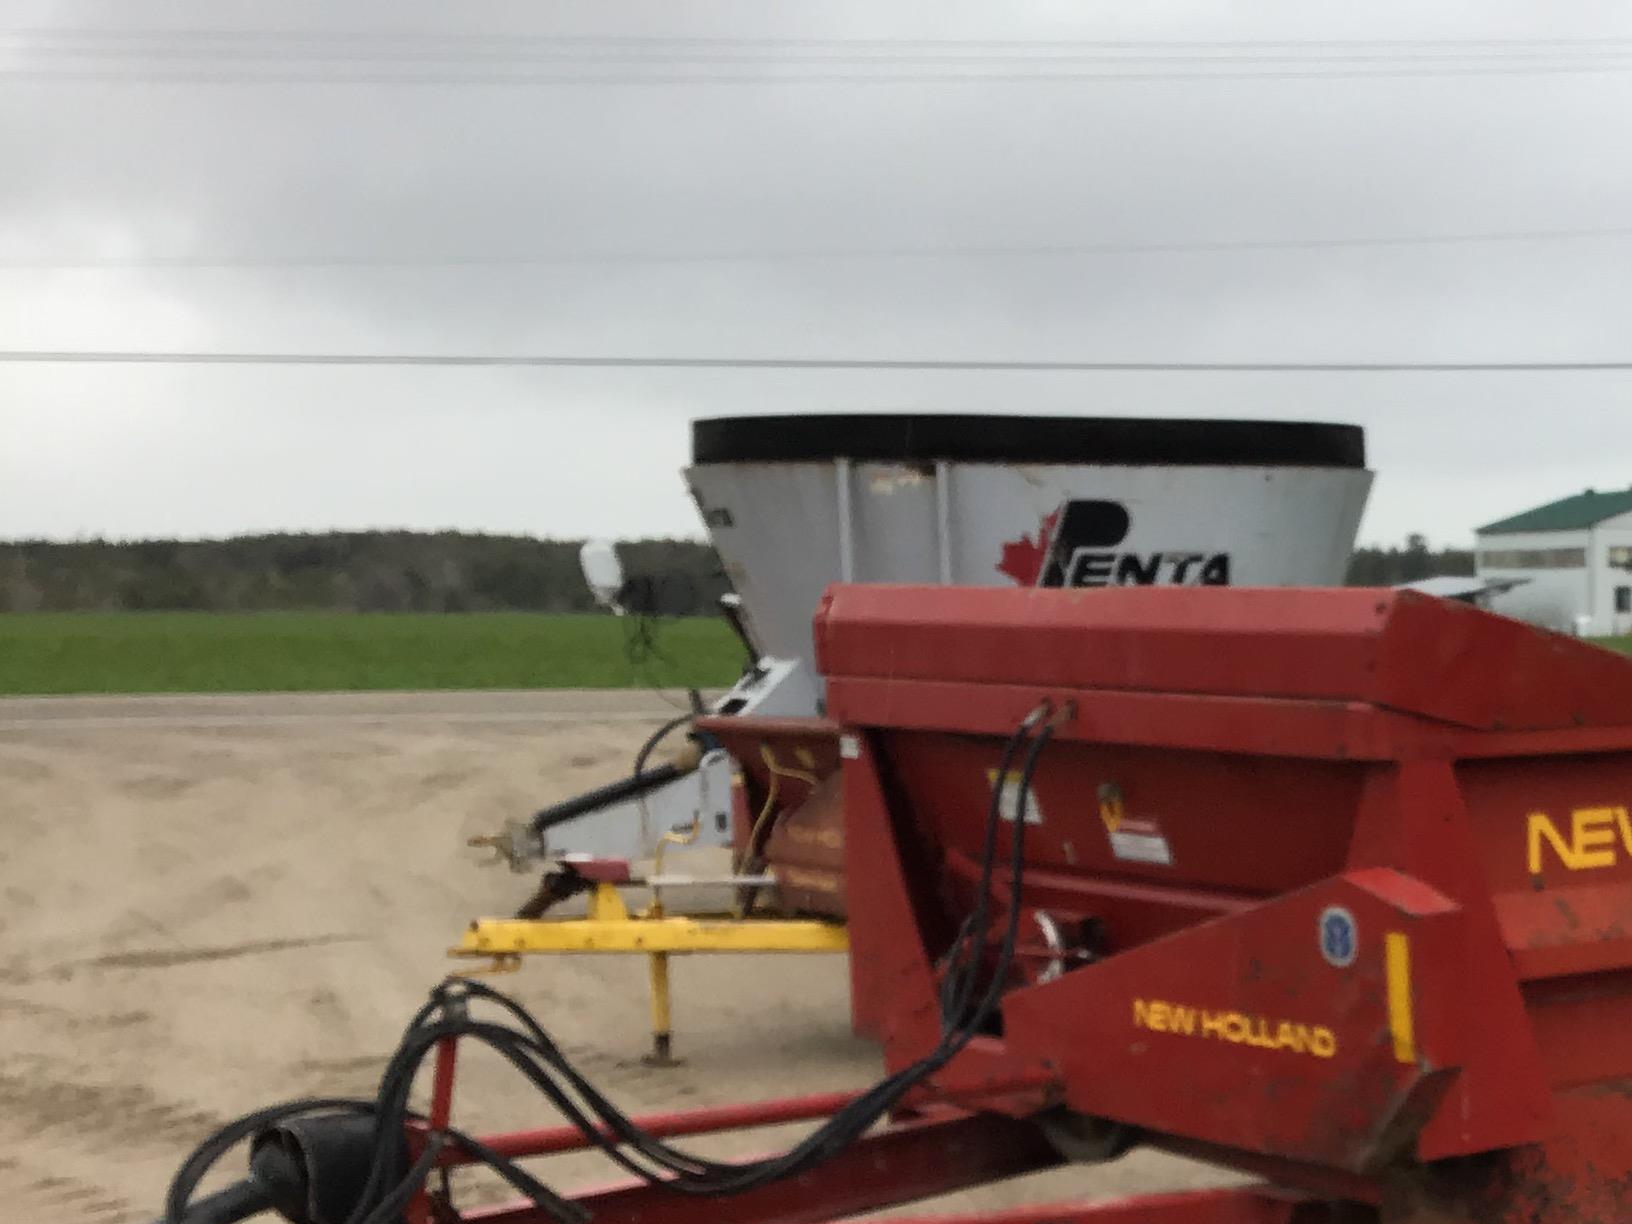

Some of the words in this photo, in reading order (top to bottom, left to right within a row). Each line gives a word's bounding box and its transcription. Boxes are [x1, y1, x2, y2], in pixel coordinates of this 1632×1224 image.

[1040, 499, 1231, 588] PENTA
[1132, 999, 1198, 1036] NEW
[1200, 1007, 1337, 1059] HOLLAND
